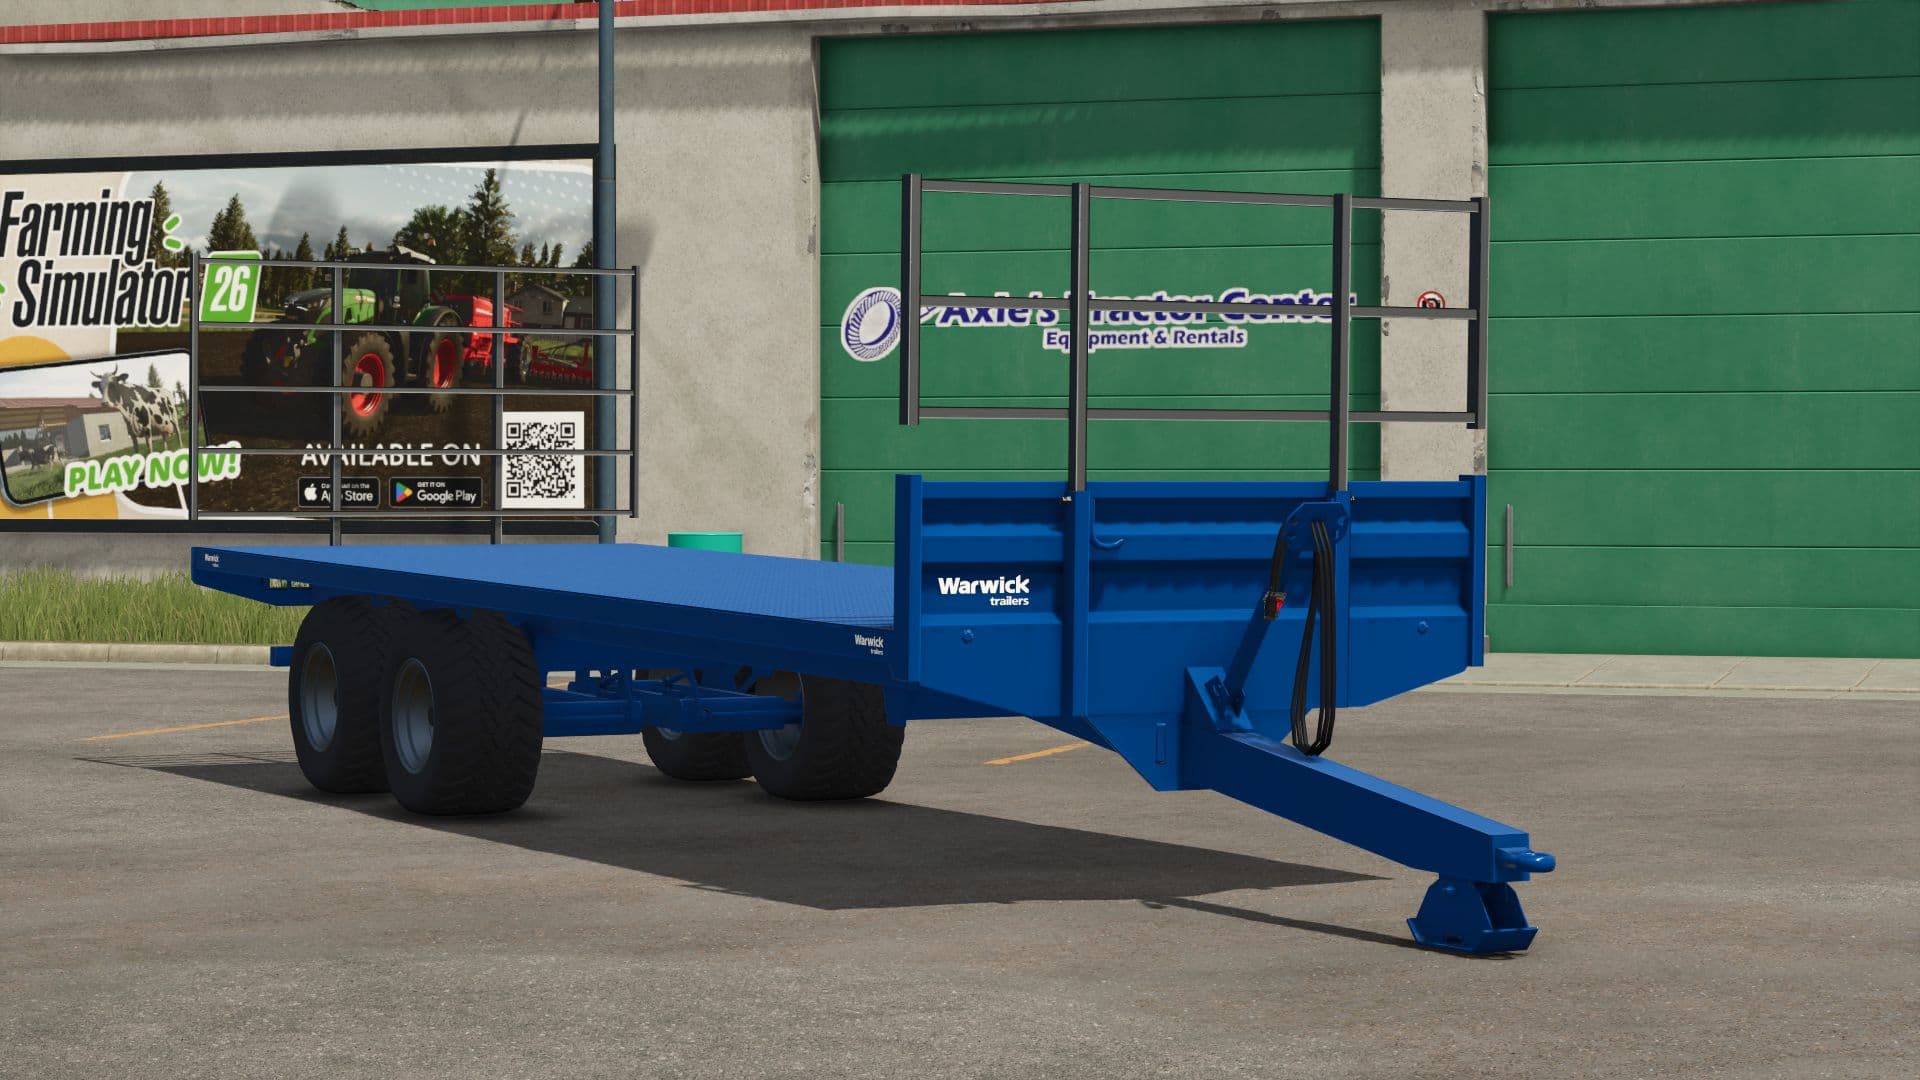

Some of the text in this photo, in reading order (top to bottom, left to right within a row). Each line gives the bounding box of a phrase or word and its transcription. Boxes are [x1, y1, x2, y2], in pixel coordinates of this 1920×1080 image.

[0, 189, 154, 266] Farming
[12, 259, 192, 327] Simulator
[210, 266, 250, 312] 26
[1067, 293, 1209, 322] ractor
[1223, 291, 1355, 321] Cente
[1047, 329, 1245, 350] Eqpment & Rentals
[441, 443, 481, 466] ON
[69, 446, 237, 493] PLAY NOW!
[345, 490, 373, 502] Store
[417, 490, 477, 504] Google Play
[938, 575, 1030, 595] Warwick
[990, 596, 1030, 606] trailers
[854, 633, 884, 648] Warwick
